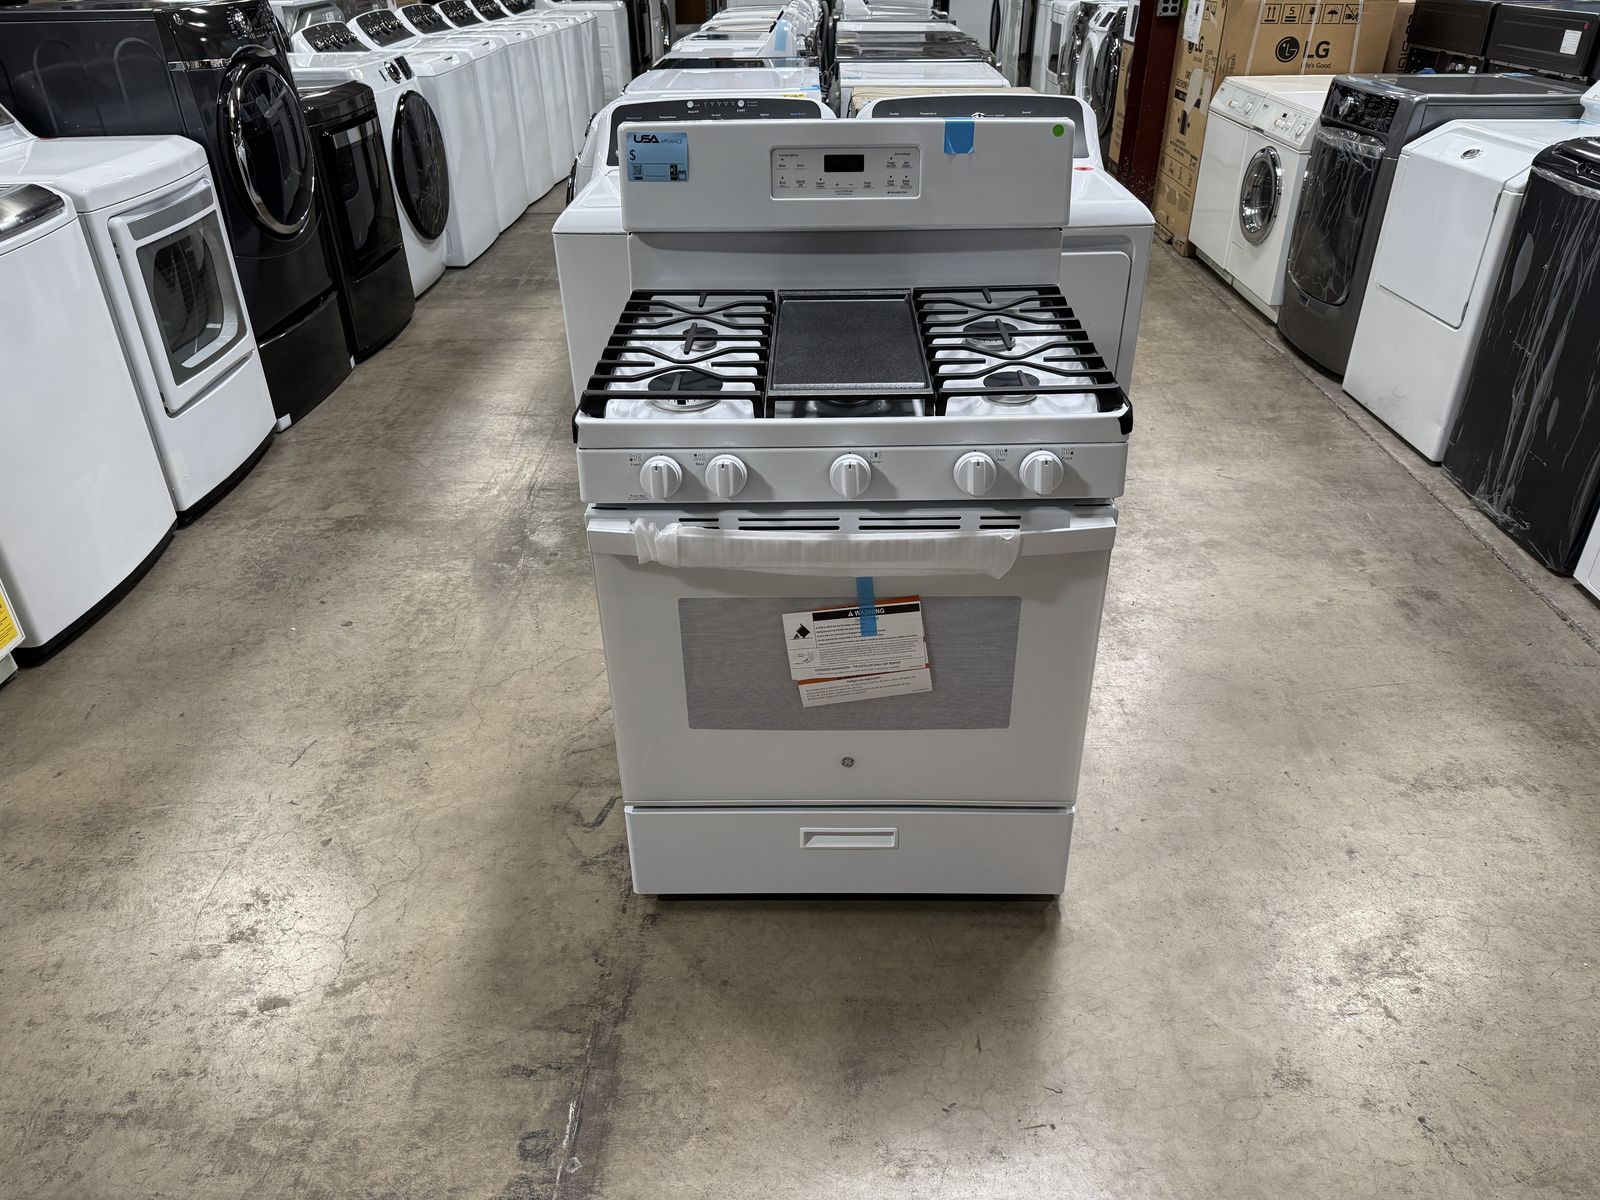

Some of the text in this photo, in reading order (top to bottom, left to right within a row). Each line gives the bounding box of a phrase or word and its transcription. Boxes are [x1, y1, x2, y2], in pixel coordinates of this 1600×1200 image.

[1303, 41, 1331, 58] LG
[633, 134, 660, 144] USA
[629, 149, 636, 161] $
[854, 608, 885, 616] WARNING
